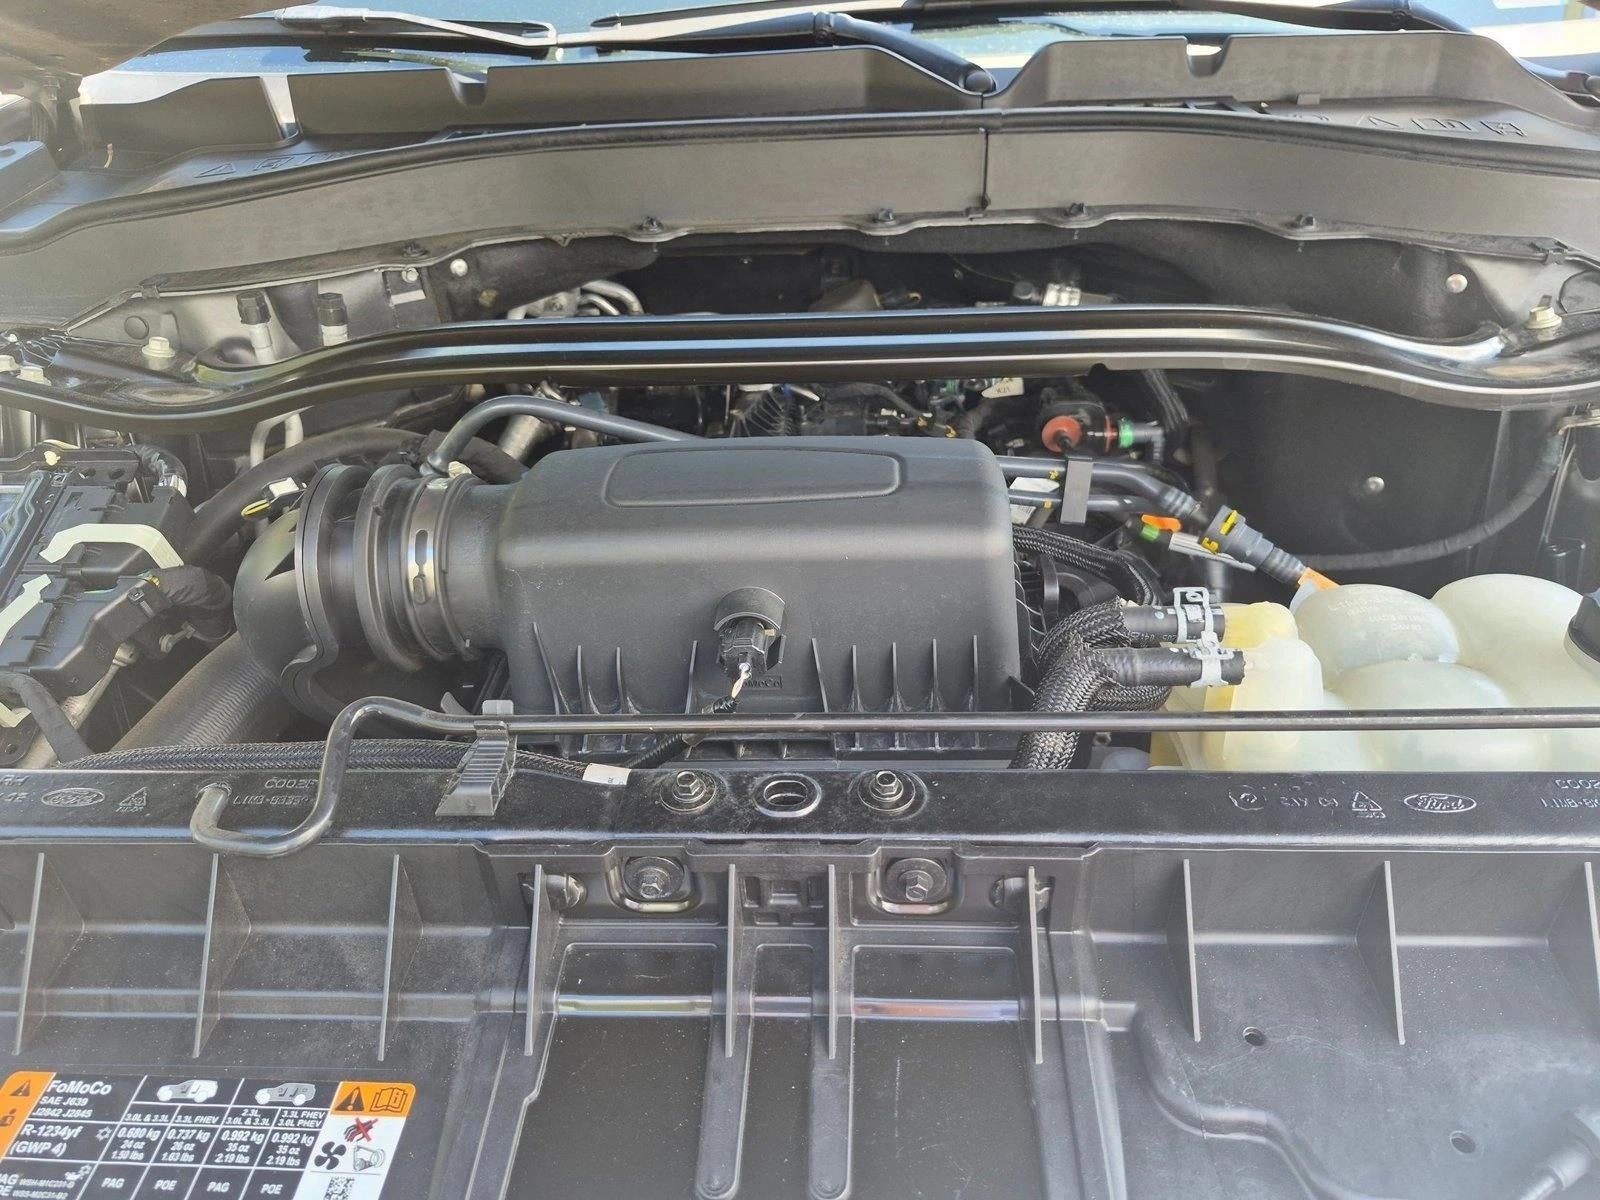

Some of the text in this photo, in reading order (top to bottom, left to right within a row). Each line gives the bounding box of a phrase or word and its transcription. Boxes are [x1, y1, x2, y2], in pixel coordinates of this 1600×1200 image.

[46, 1080, 112, 1095] FoMoCo
[40, 1096, 88, 1106] SAE J639
[193, 1116, 219, 1124] FHEV
[301, 1111, 325, 1119] FHEV
[297, 1119, 322, 1127] PHEV
[21, 1124, 83, 1140] R-1234yf
[146, 1128, 160, 1141] kg
[196, 1129, 210, 1142] kg
[221, 1130, 265, 1144] 0.992 kg
[271, 1132, 314, 1146] 0.992 kg
[10, 1141, 67, 1157] (GWP 4)
[133, 1141, 145, 1149] oz
[183, 1143, 195, 1151] oz
[225, 1142, 250, 1152] 35 oz
[276, 1145, 300, 1155] 35 oz
[129, 1151, 144, 1160] lbs
[180, 1152, 194, 1162] lbs
[236, 1154, 250, 1163] lbs
[286, 1156, 300, 1166] lbs
[0, 1173, 19, 1185] AG
[101, 1177, 125, 1189] PAG
[154, 1180, 177, 1191] POE
[206, 1181, 230, 1192] PAG
[261, 1184, 284, 1195] POE
